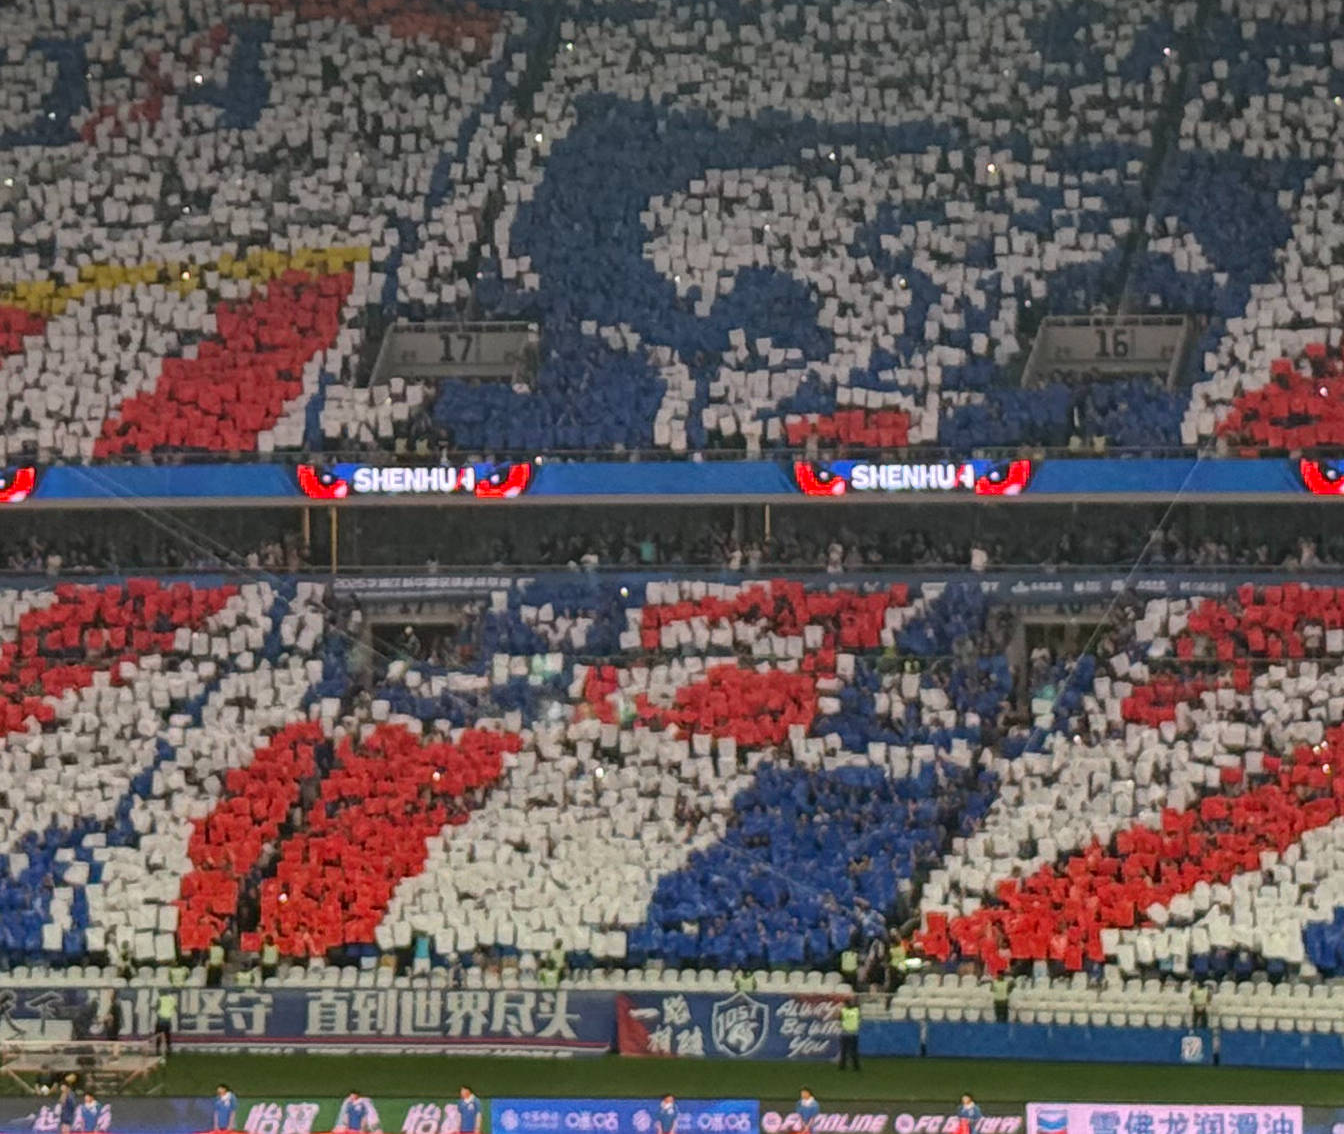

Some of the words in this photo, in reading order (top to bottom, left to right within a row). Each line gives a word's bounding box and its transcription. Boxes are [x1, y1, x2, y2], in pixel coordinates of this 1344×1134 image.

[439, 334, 473, 362] 17
[1096, 329, 1128, 357] 16
[353, 467, 475, 492] SHENHUA
[850, 464, 975, 488] SHENHUA
[304, 988, 582, 1040] 直到世界尽头
